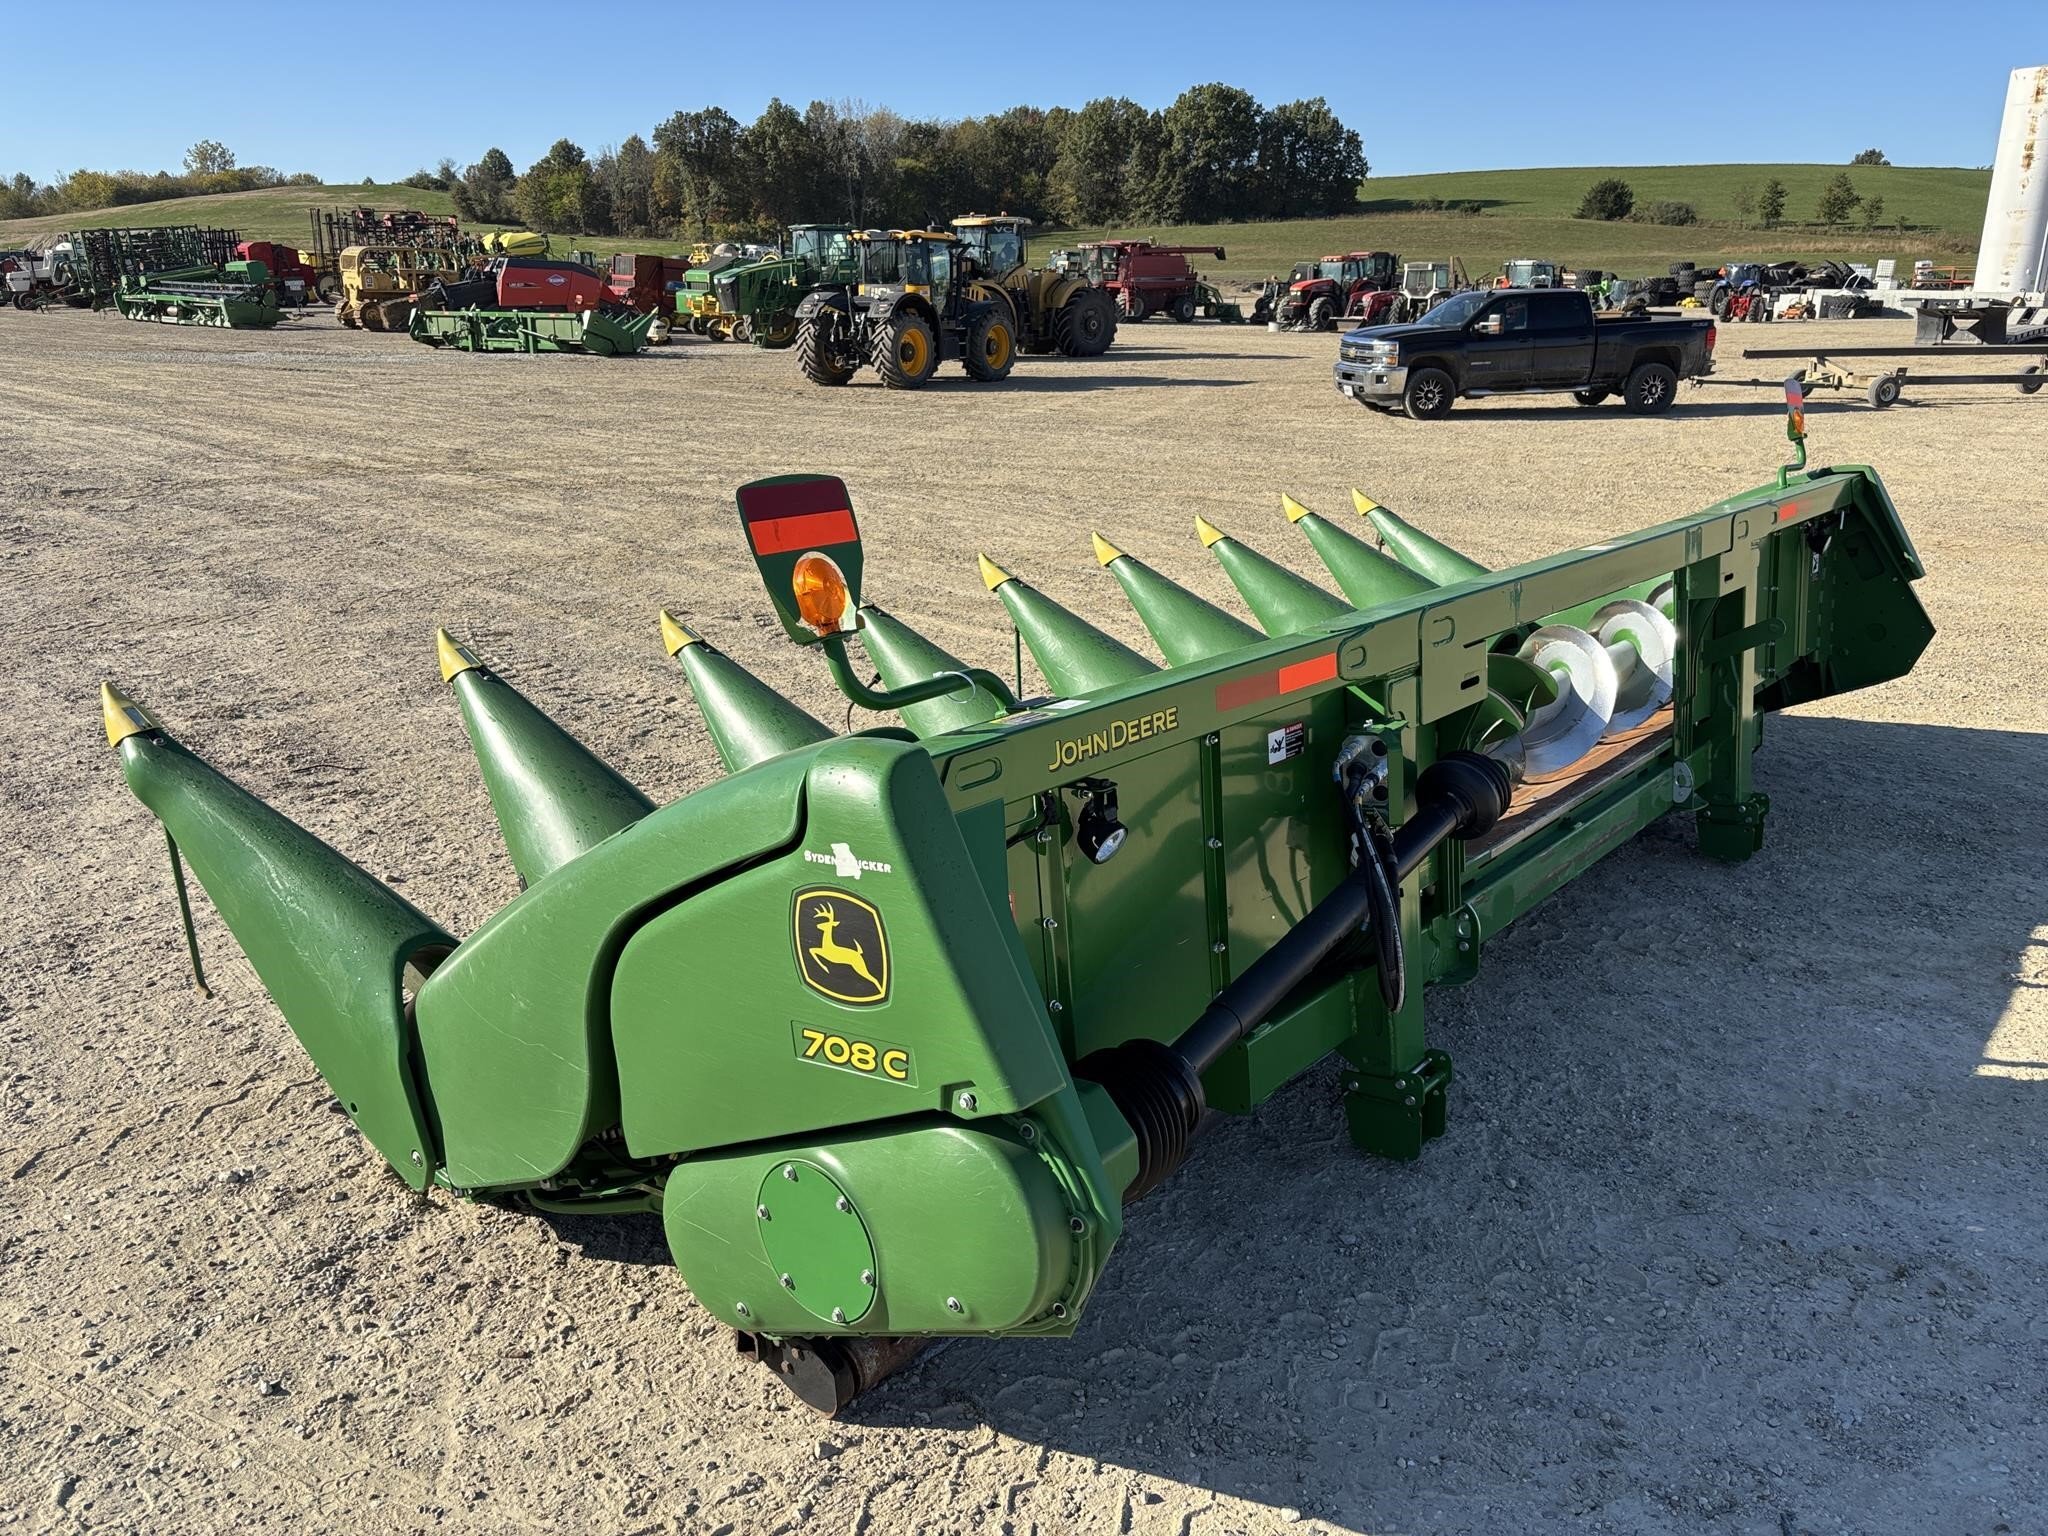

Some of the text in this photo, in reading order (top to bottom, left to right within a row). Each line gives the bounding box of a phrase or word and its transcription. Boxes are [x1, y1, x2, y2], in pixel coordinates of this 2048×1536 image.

[1048, 706, 1178, 771] JOHN DEERE
[802, 1027, 909, 1080] 708 C
